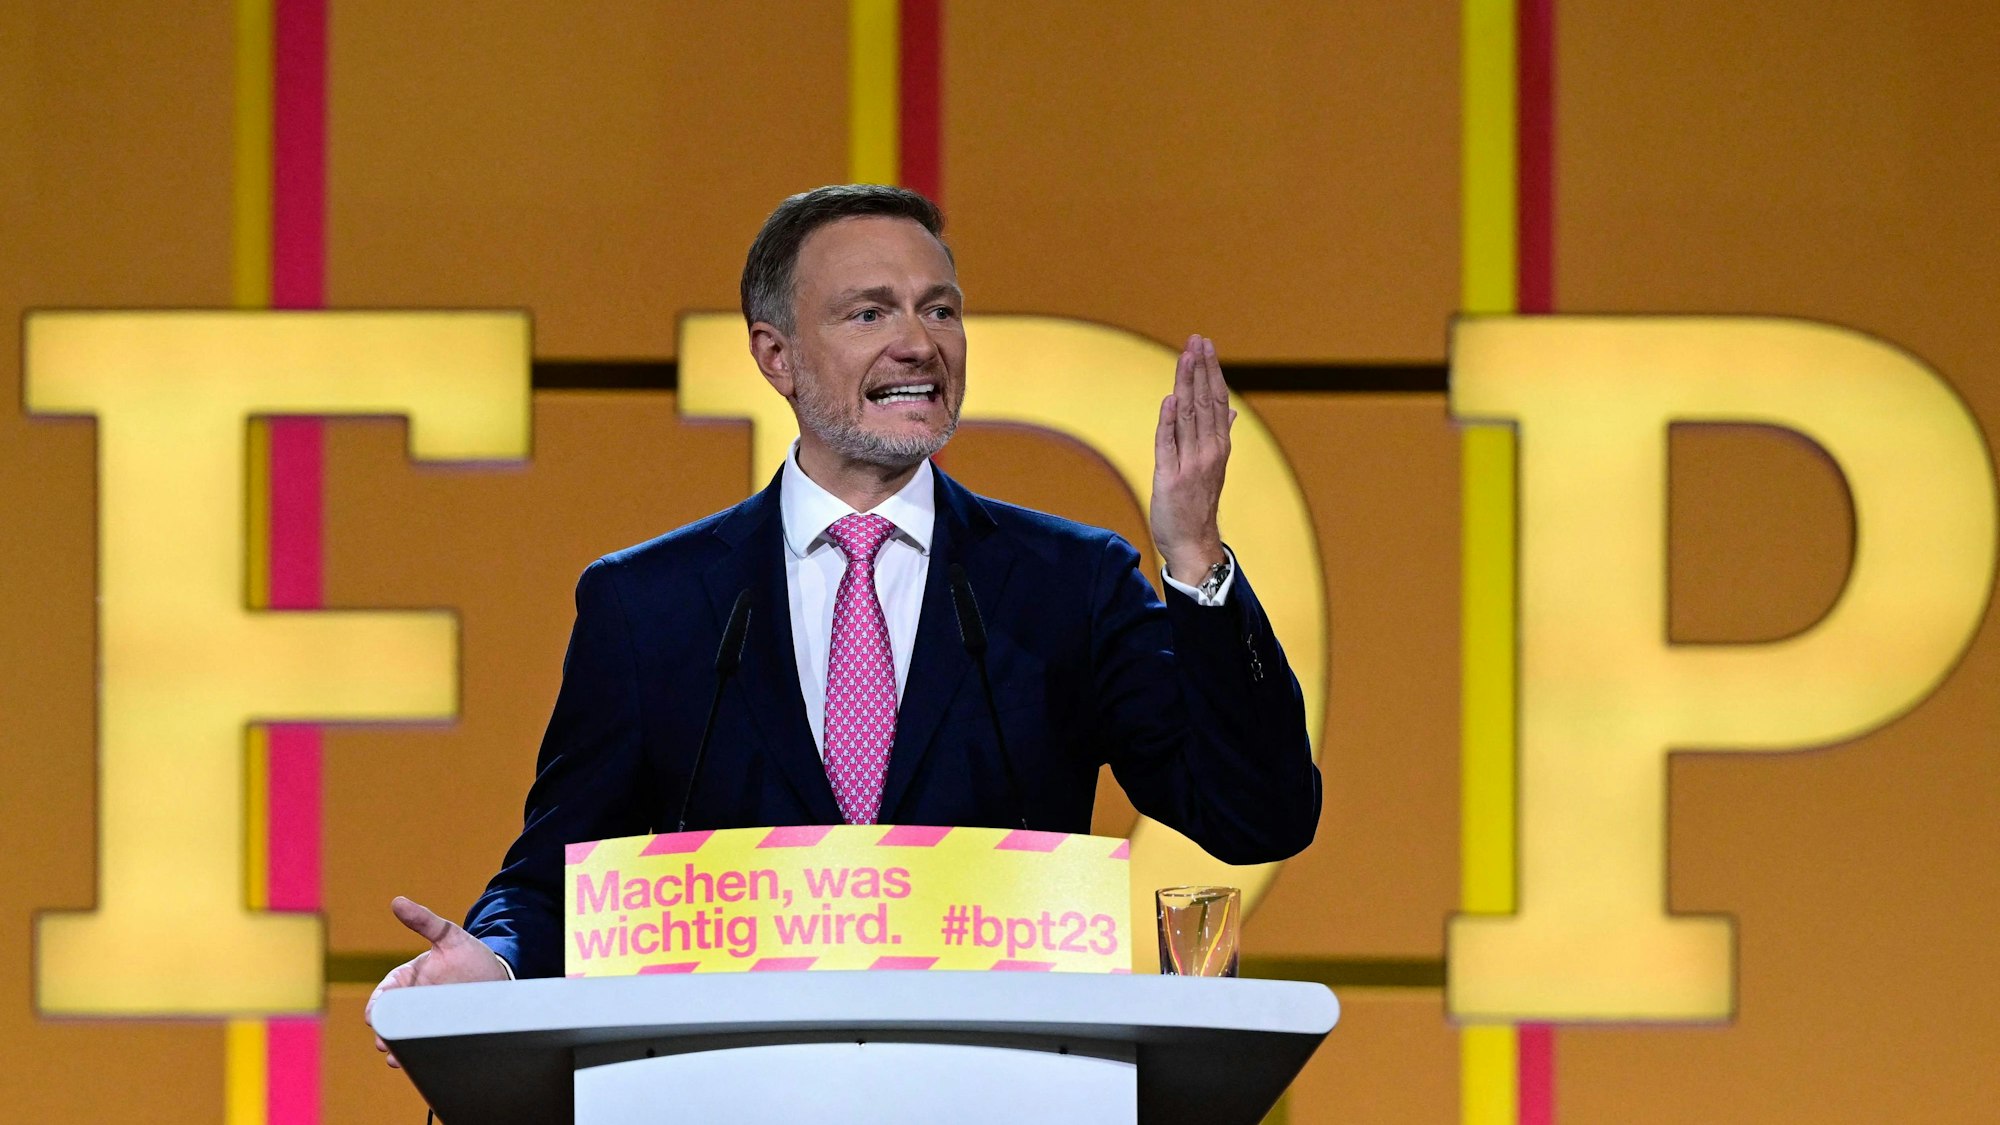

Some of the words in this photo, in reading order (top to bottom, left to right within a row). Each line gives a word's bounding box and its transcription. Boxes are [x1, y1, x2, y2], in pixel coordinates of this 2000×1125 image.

[576, 863, 794, 915] Machen,
[804, 867, 912, 899] was
[575, 907, 758, 960] wichtig
[775, 902, 903, 946] wird.
[941, 904, 1118, 959] #bpt23
